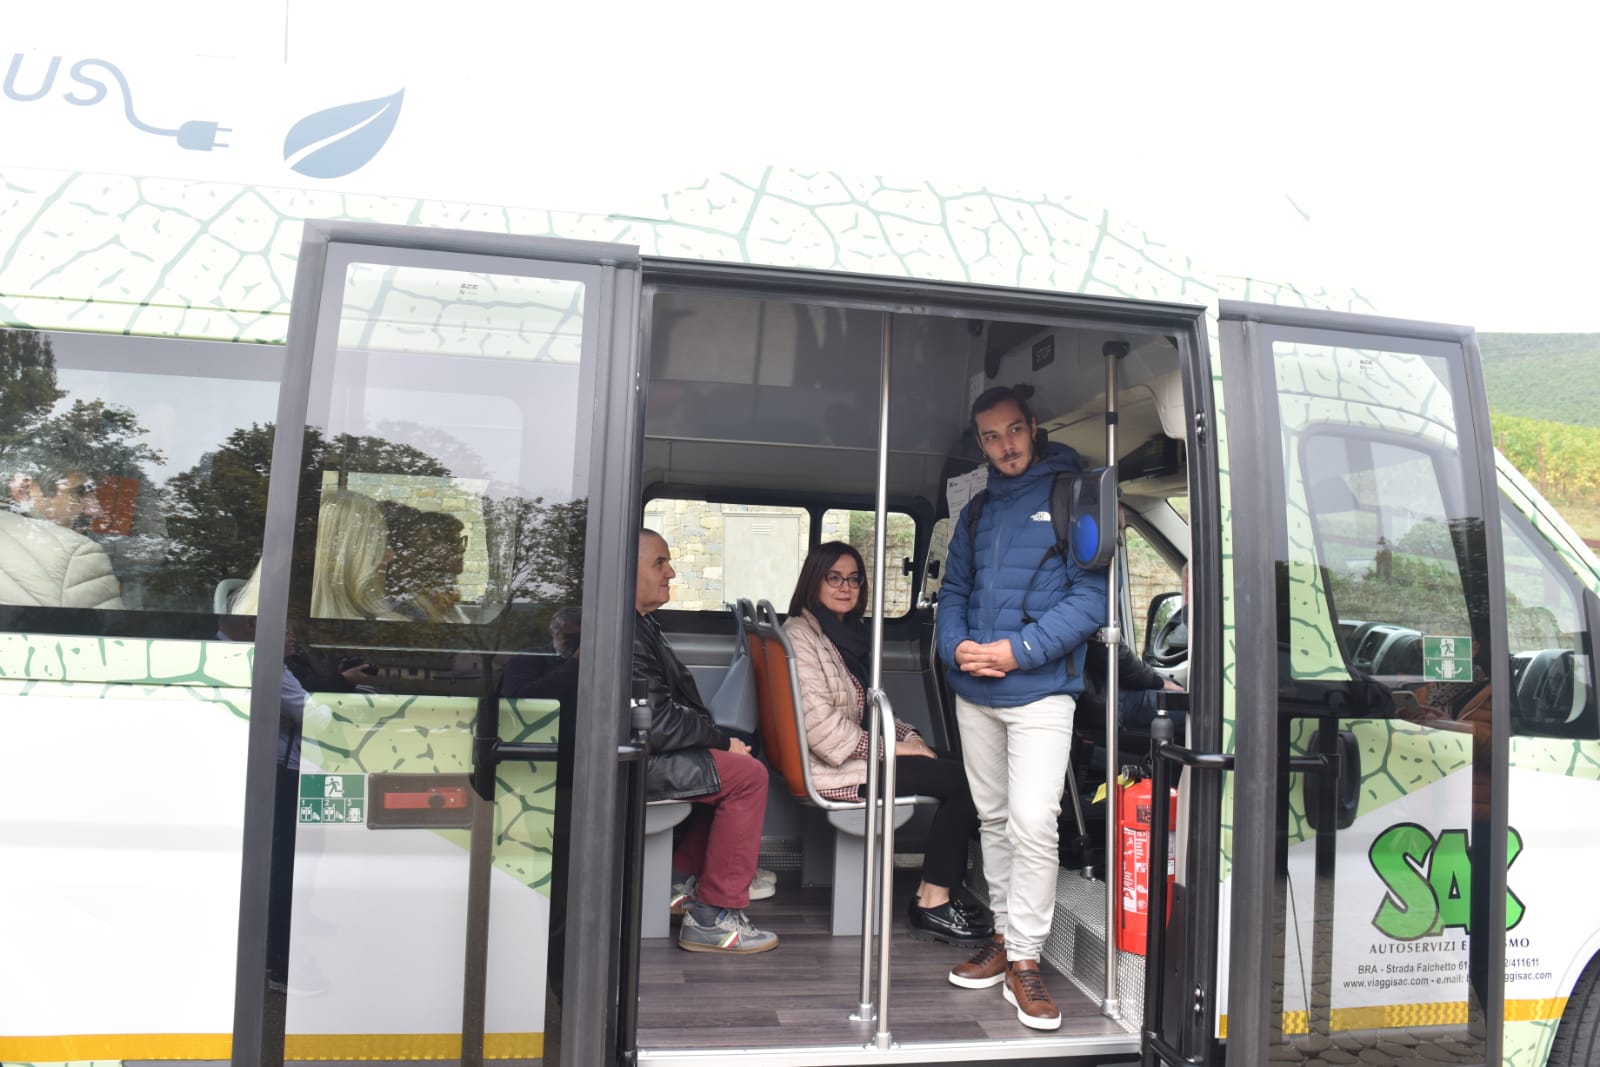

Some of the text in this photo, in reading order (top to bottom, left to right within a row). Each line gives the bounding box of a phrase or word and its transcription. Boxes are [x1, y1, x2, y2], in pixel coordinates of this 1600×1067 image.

[3, 53, 108, 106] US
[1369, 942, 1455, 954] AUTOSERVIZI
[1461, 941, 1468, 951] E
[1358, 964, 1377, 974] BRA
[1386, 963, 1414, 974] Strada
[1343, 976, 1429, 988] www.viaggisac.com
